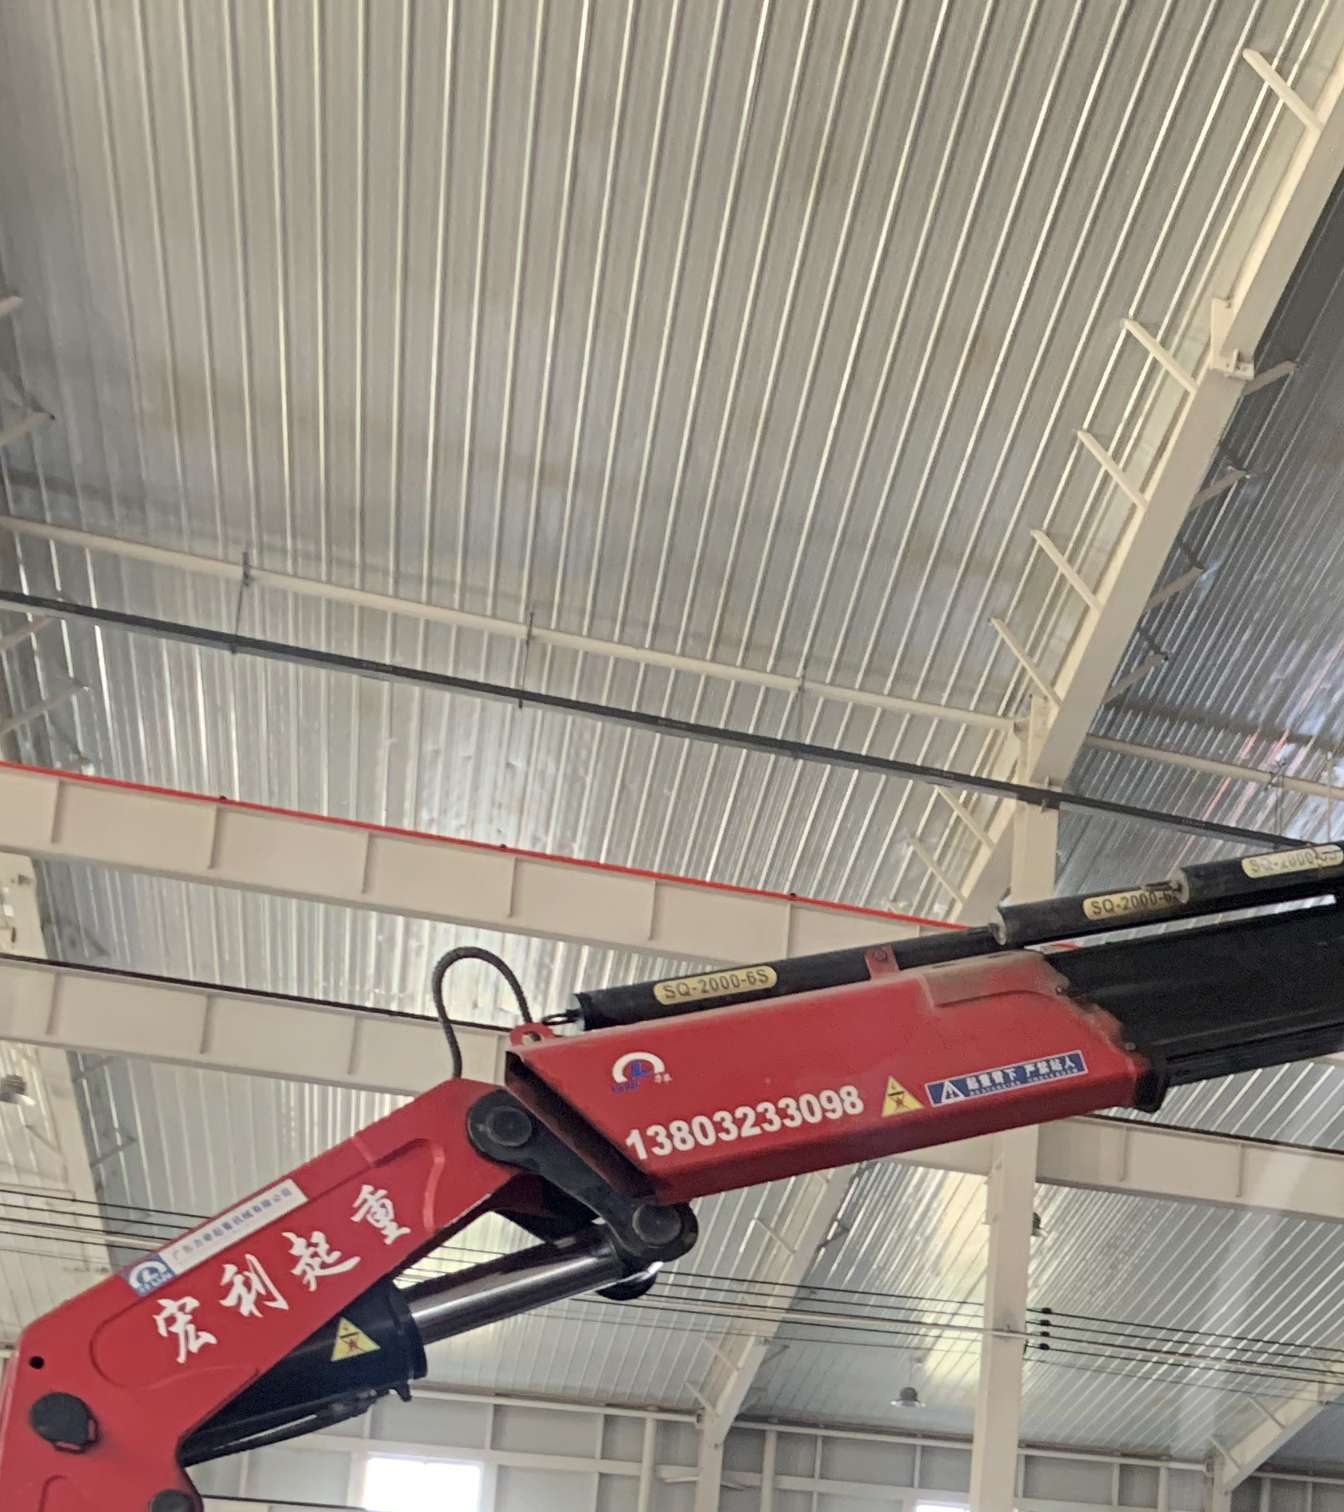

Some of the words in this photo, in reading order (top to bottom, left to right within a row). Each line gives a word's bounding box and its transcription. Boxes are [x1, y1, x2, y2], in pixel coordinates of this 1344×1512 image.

[1090, 888, 1178, 915] SQ-2000-6
[662, 968, 770, 999] SQ-2000-6S
[625, 1086, 864, 1160] 13803233098
